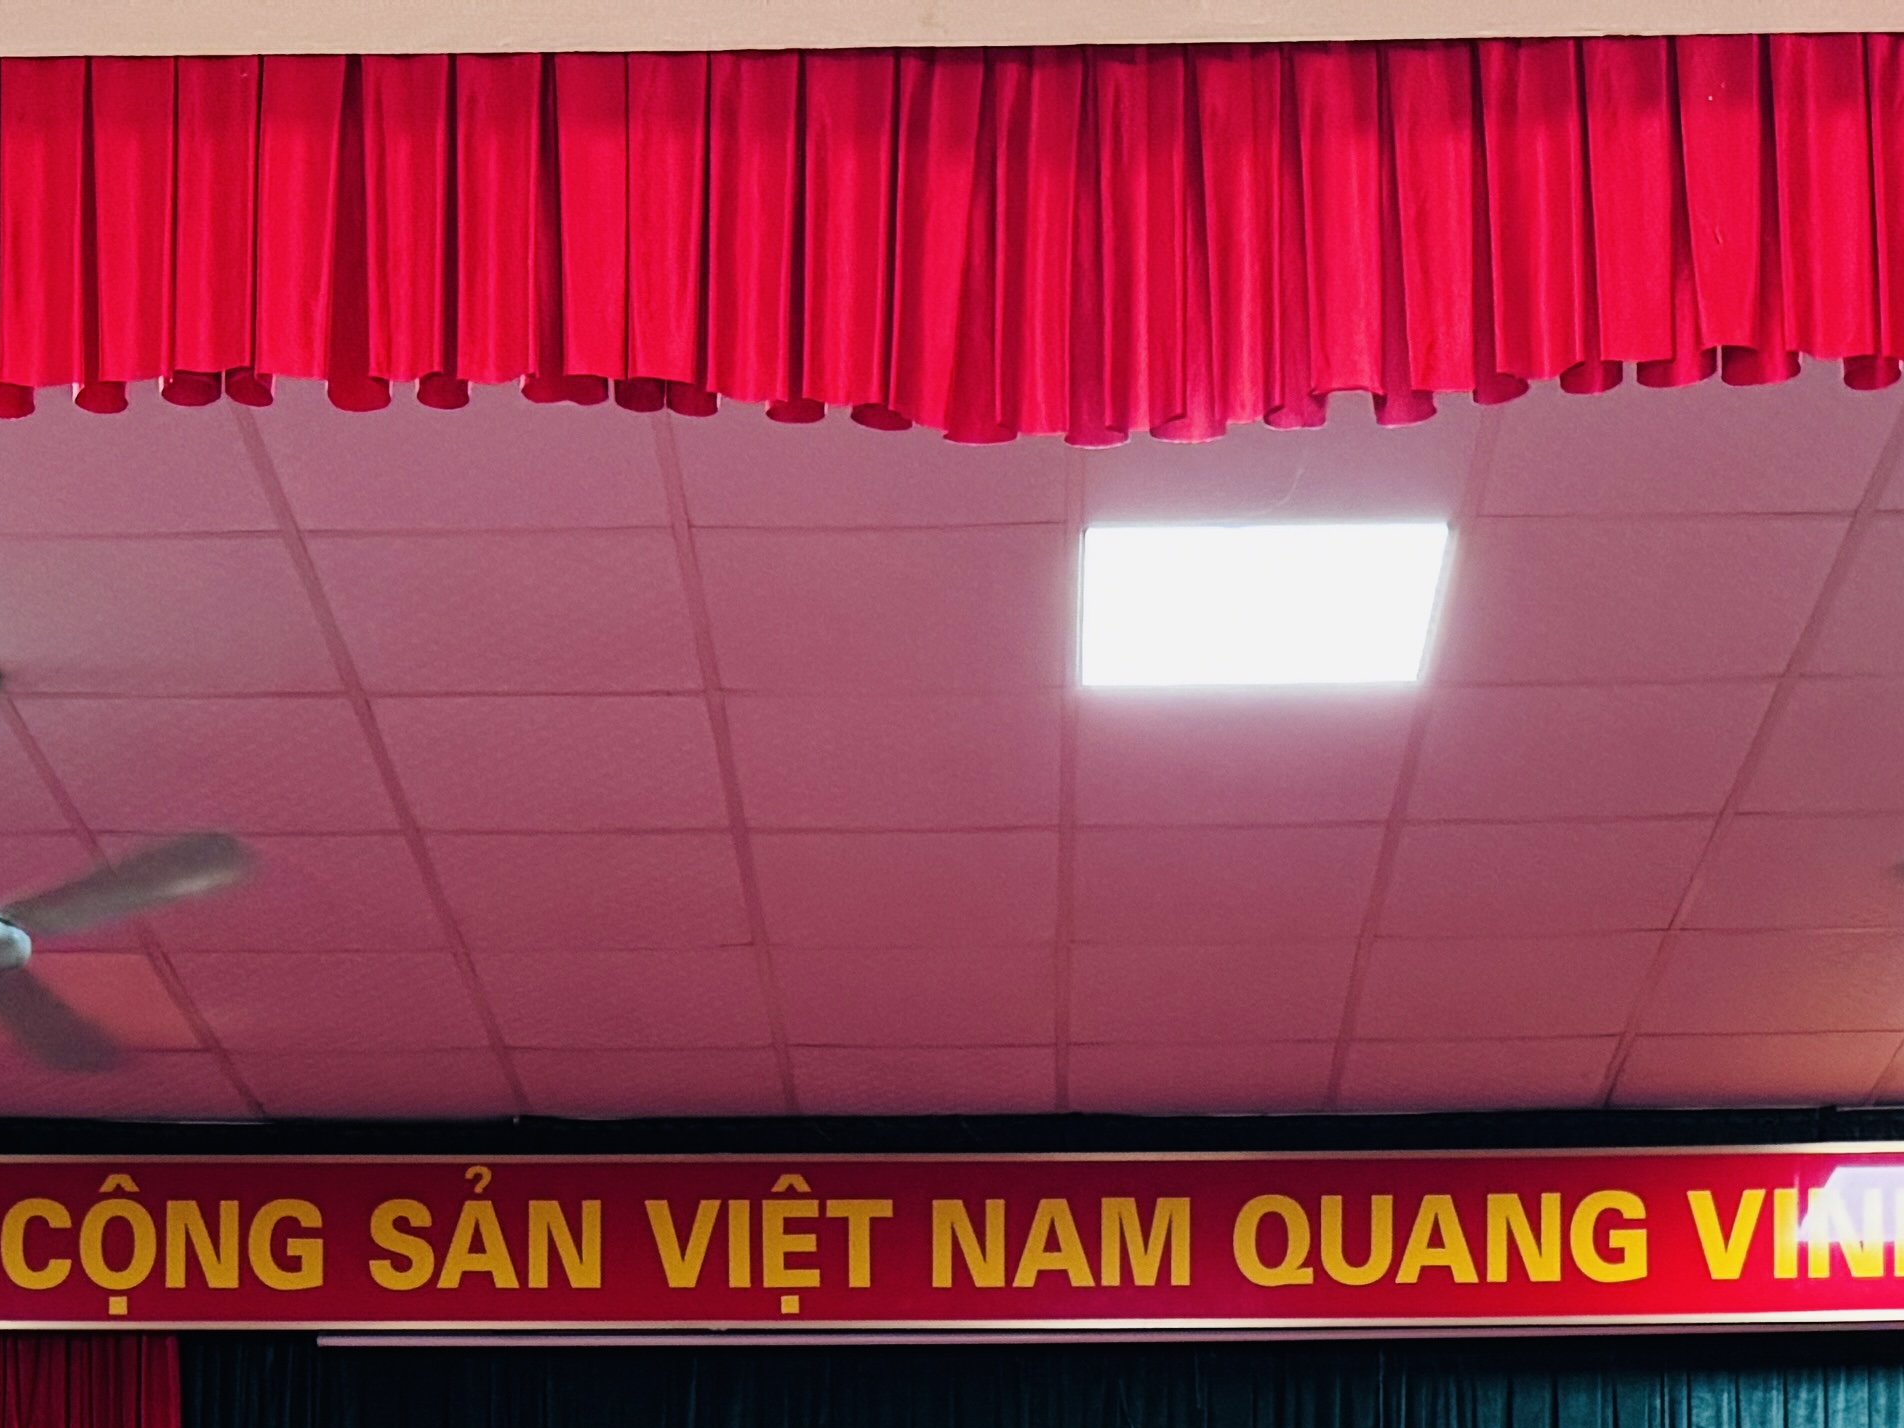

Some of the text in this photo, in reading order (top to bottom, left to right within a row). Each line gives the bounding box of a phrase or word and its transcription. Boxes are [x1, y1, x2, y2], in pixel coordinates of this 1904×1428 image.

[1, 1172, 325, 1315] CỘNG
[369, 1164, 602, 1290] SẢN
[647, 1173, 893, 1315] VIỆT
[932, 1194, 1192, 1288] NAM
[1232, 1189, 1650, 1287] QUANG
